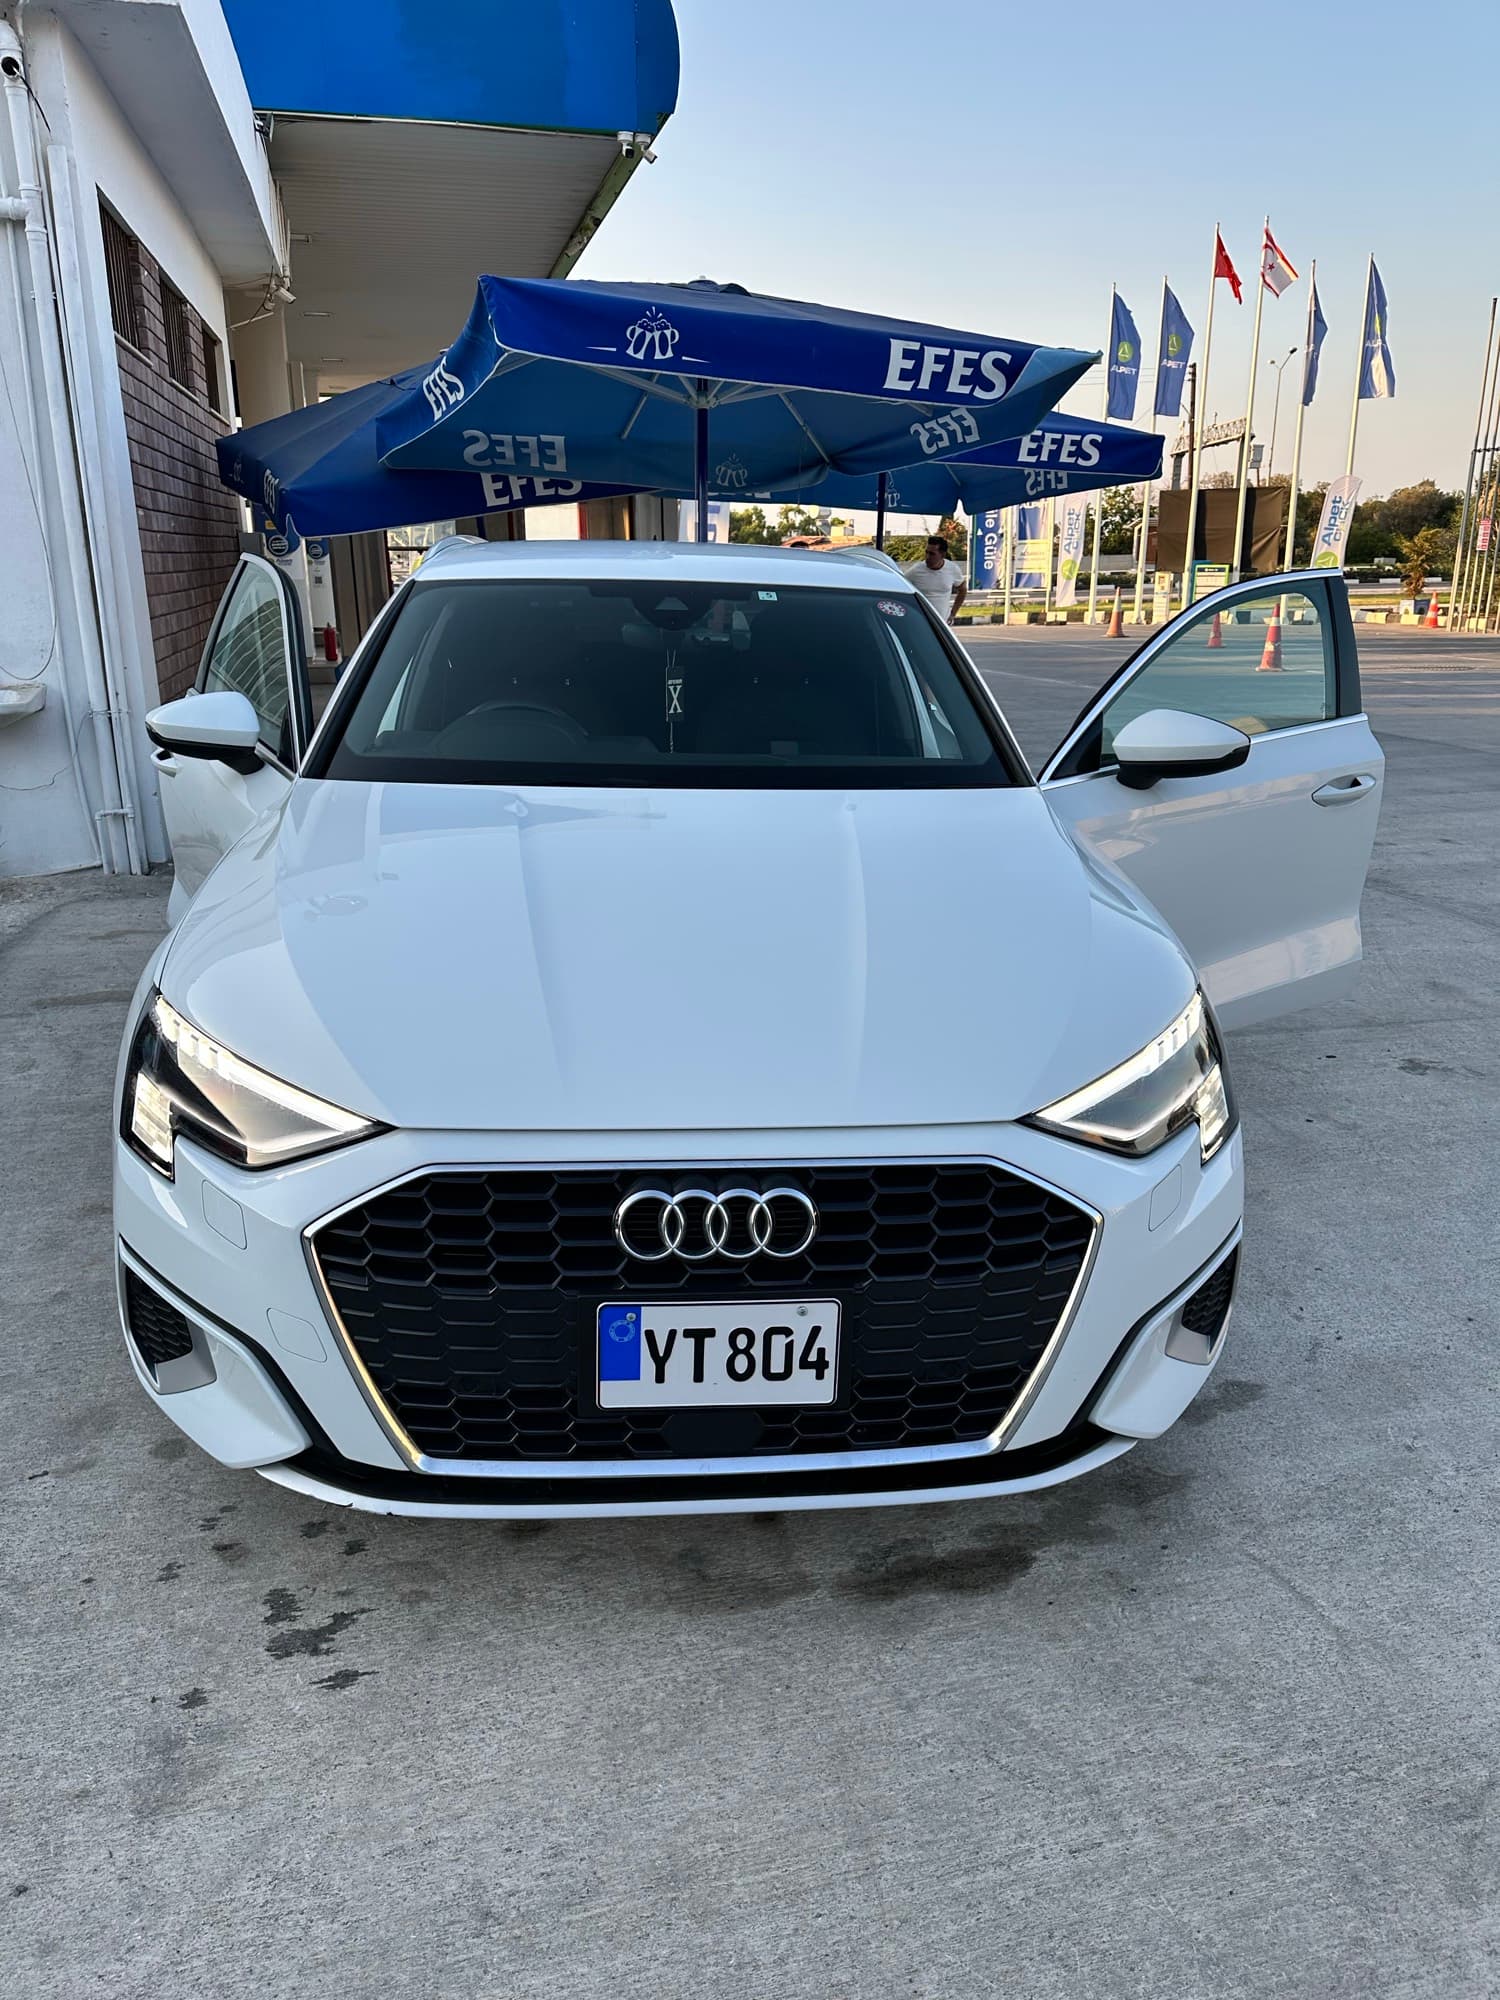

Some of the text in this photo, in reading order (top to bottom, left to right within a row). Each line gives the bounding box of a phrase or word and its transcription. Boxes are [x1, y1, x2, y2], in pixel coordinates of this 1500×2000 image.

[422, 356, 465, 422] EFES
[883, 338, 1012, 400] EFES
[1017, 430, 1103, 467] EFES
[1063, 508, 1076, 555] Alpet
[1321, 495, 1343, 547] Alpet
[983, 532, 998, 570] Güle
[644, 1327, 717, 1384] YT
[726, 1325, 830, 1383] 804
